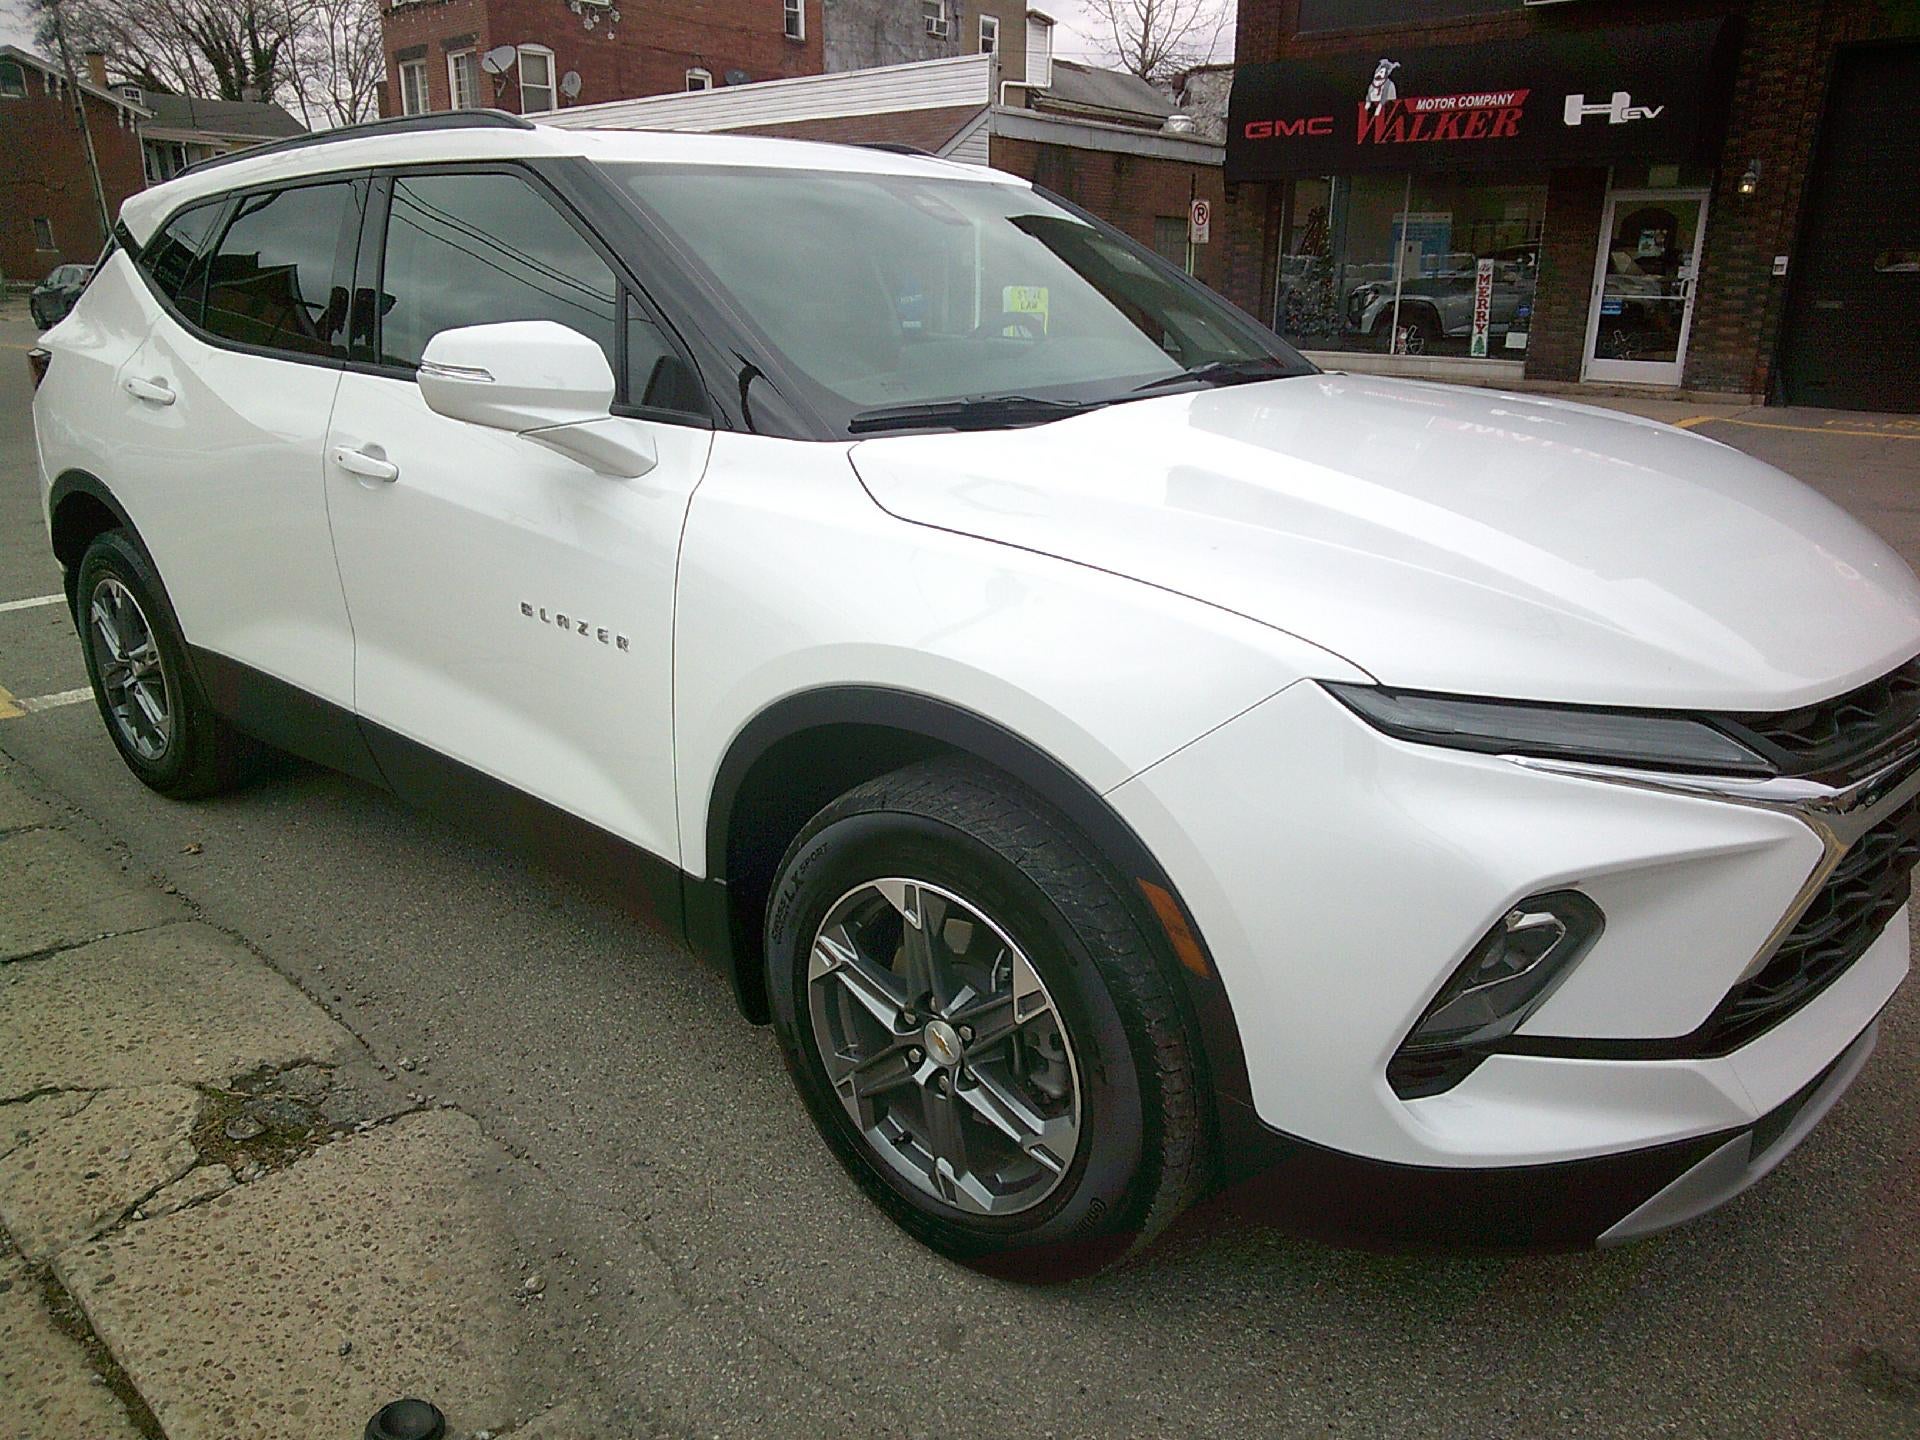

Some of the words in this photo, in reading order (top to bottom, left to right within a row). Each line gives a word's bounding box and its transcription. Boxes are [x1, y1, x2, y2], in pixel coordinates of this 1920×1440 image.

[1416, 96, 1456, 110] MOTOR
[1458, 93, 1514, 108] COMPANY
[1245, 116, 1334, 139] GMC
[1357, 100, 1523, 144] WALKER
[1475, 273, 1491, 335] MERRY
[520, 601, 631, 653] BLAZER
[799, 842, 829, 874] SPORT
